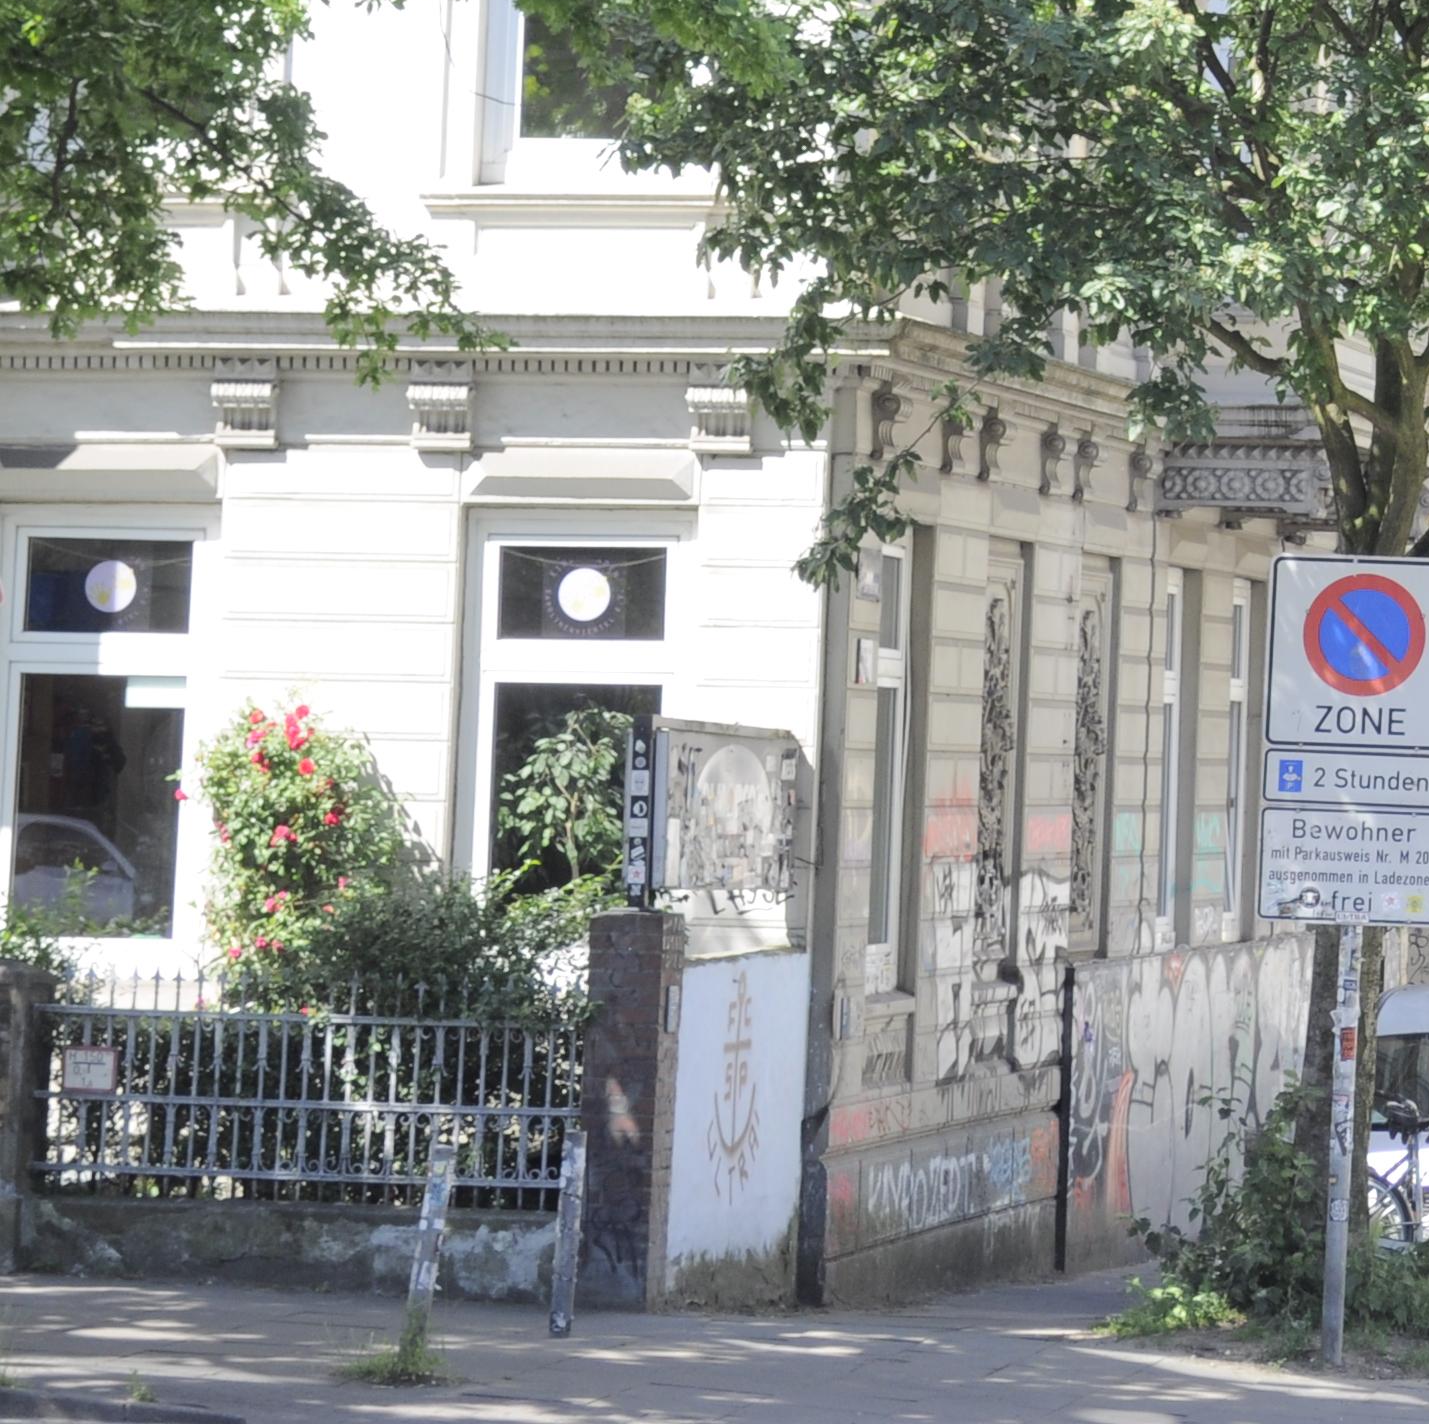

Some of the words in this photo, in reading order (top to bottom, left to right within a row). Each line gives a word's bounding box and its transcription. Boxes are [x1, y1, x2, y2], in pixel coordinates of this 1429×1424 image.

[1314, 705, 1407, 736] ZONE
[1313, 767, 1326, 788] 2
[1334, 768, 1429, 792] Stunden
[1292, 818, 1416, 843] Bewohner
[1271, 847, 1290, 860] mit
[1294, 847, 1370, 862] Parkausweis
[1376, 850, 1392, 864] Nr.
[1400, 851, 1410, 864] M
[1268, 869, 1353, 884] ausgenommen
[1358, 870, 1369, 883] in
[1331, 891, 1373, 912] frei
